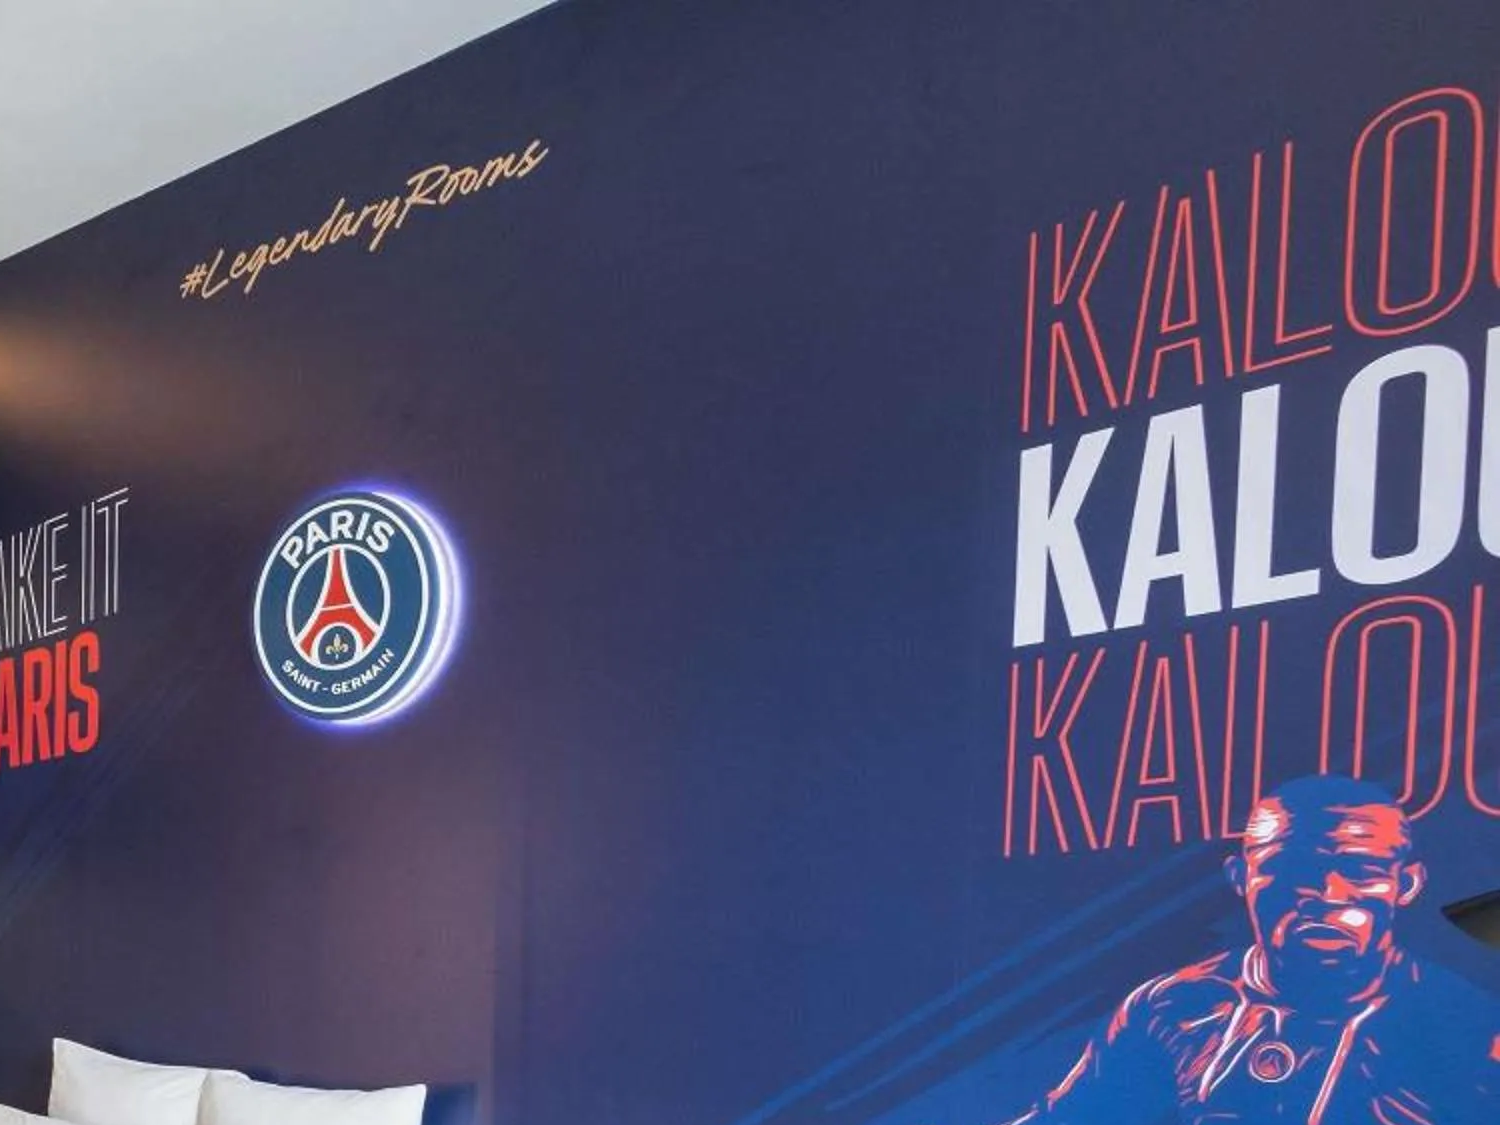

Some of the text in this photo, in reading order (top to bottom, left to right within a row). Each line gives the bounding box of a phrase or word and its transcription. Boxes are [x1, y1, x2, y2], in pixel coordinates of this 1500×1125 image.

[180, 139, 548, 299] #LegendaryRooms
[1021, 87, 1500, 433] KALO
[81, 486, 129, 624] IT
[280, 509, 395, 569] PARIS
[1011, 326, 1500, 648] KALO
